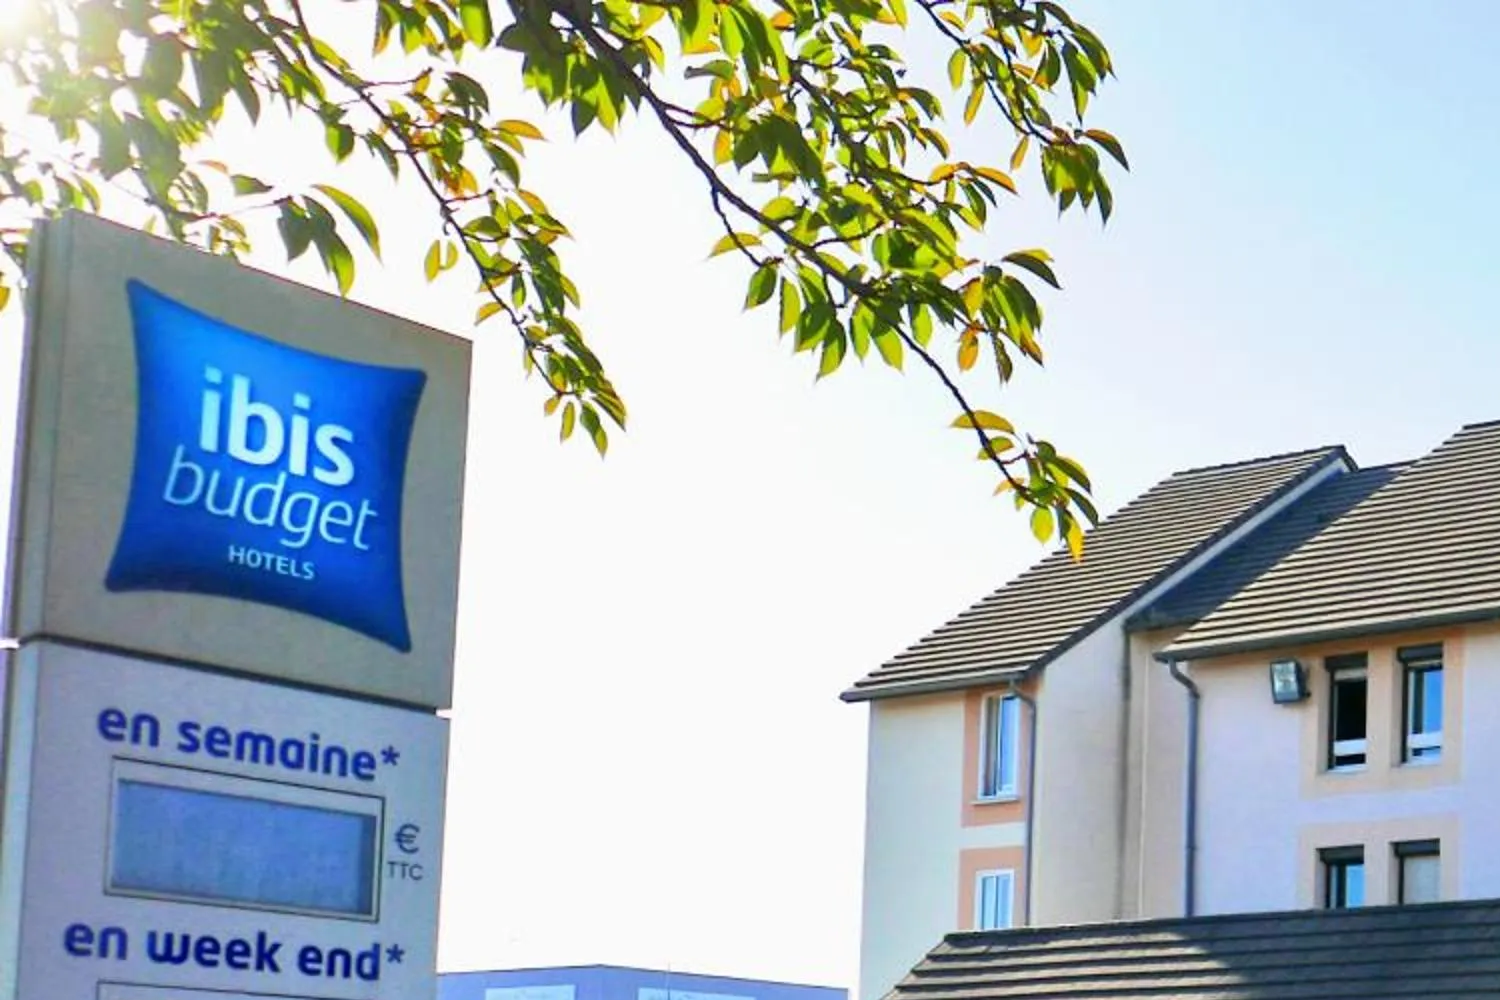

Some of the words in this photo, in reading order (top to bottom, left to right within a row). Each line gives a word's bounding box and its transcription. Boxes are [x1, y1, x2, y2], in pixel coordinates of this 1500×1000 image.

[199, 364, 355, 487] ibis
[162, 444, 378, 550] budget
[228, 544, 315, 581] HOTELS
[97, 707, 160, 748] en
[393, 823, 421, 854] €
[387, 860, 424, 881] TTC
[63, 922, 129, 960] en
[146, 930, 283, 973] week
